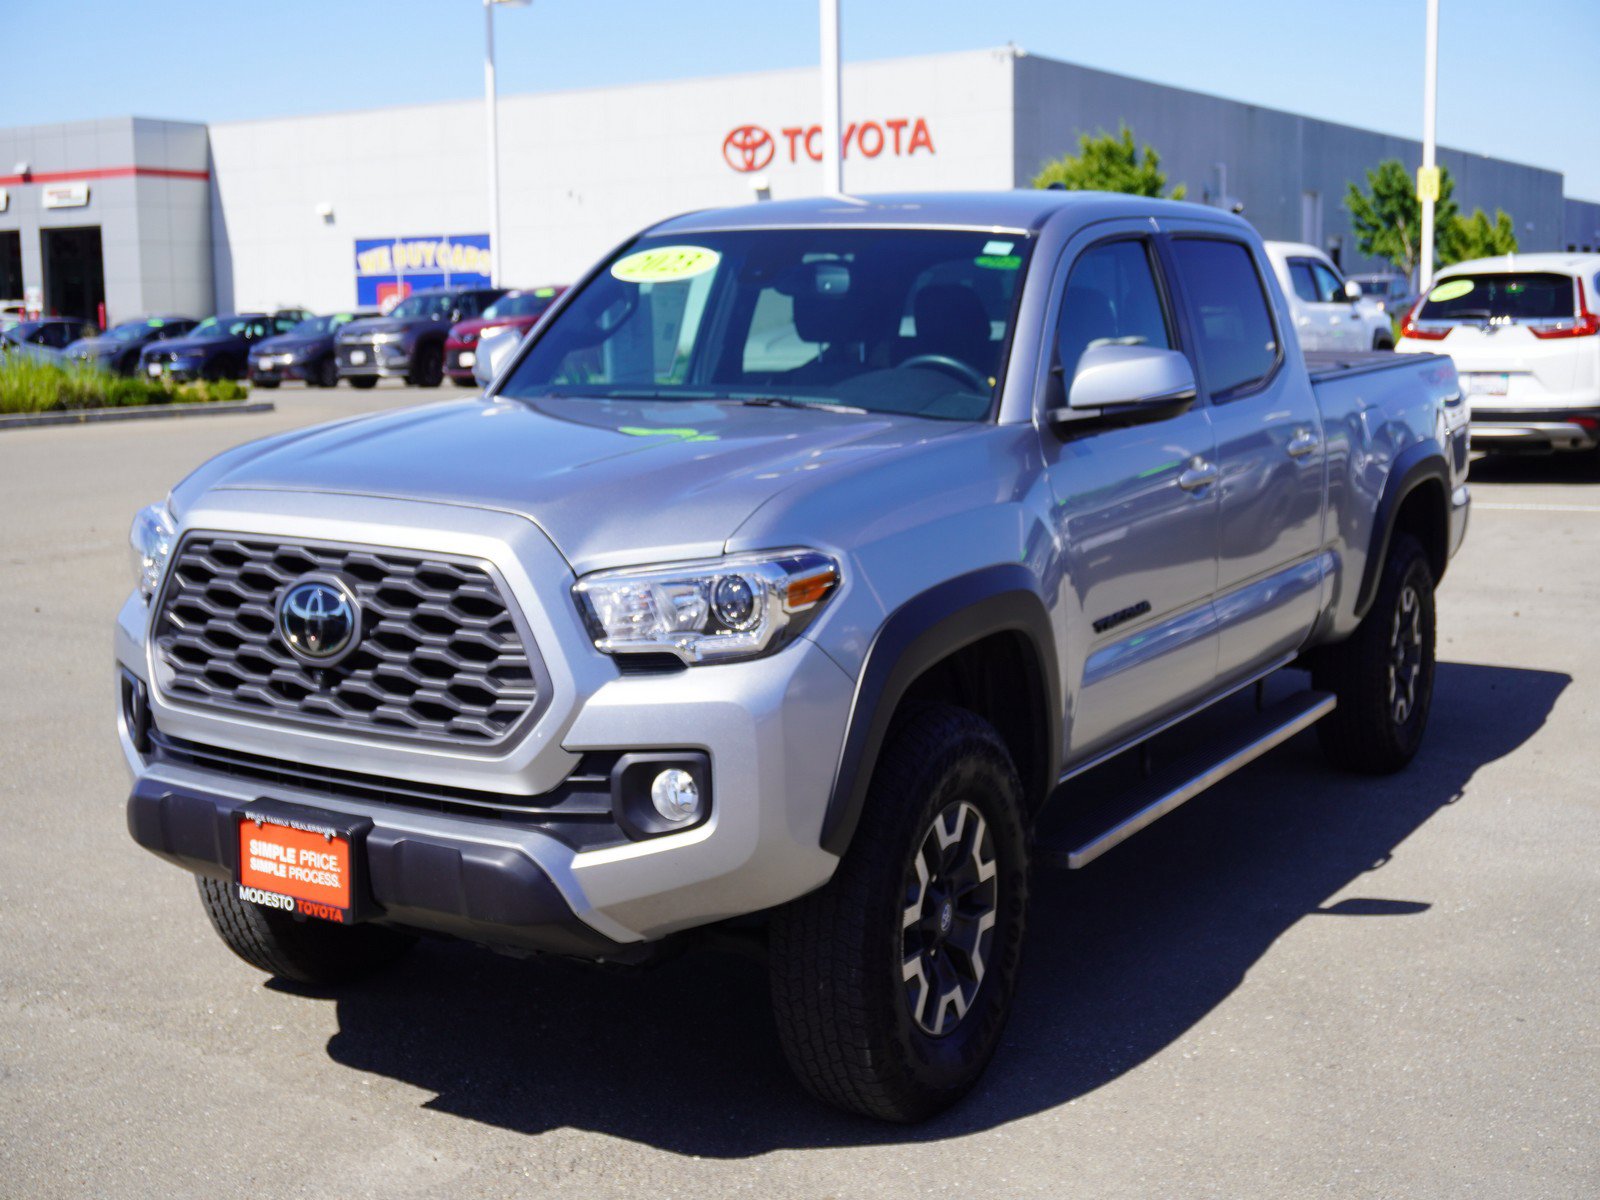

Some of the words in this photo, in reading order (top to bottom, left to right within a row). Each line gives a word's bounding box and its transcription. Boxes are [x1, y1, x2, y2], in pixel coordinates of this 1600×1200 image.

[782, 118, 935, 164] TOYOTA
[358, 245, 392, 275] WE
[392, 241, 438, 268] BUY
[436, 242, 491, 277] CARS
[249, 839, 297, 864] SIMPLE
[299, 850, 341, 873] PRICE.
[250, 857, 287, 878] SIMPLE
[288, 867, 341, 888] PROCESS.
[239, 885, 295, 912] MODESTO
[296, 899, 344, 923] TOYOTA
